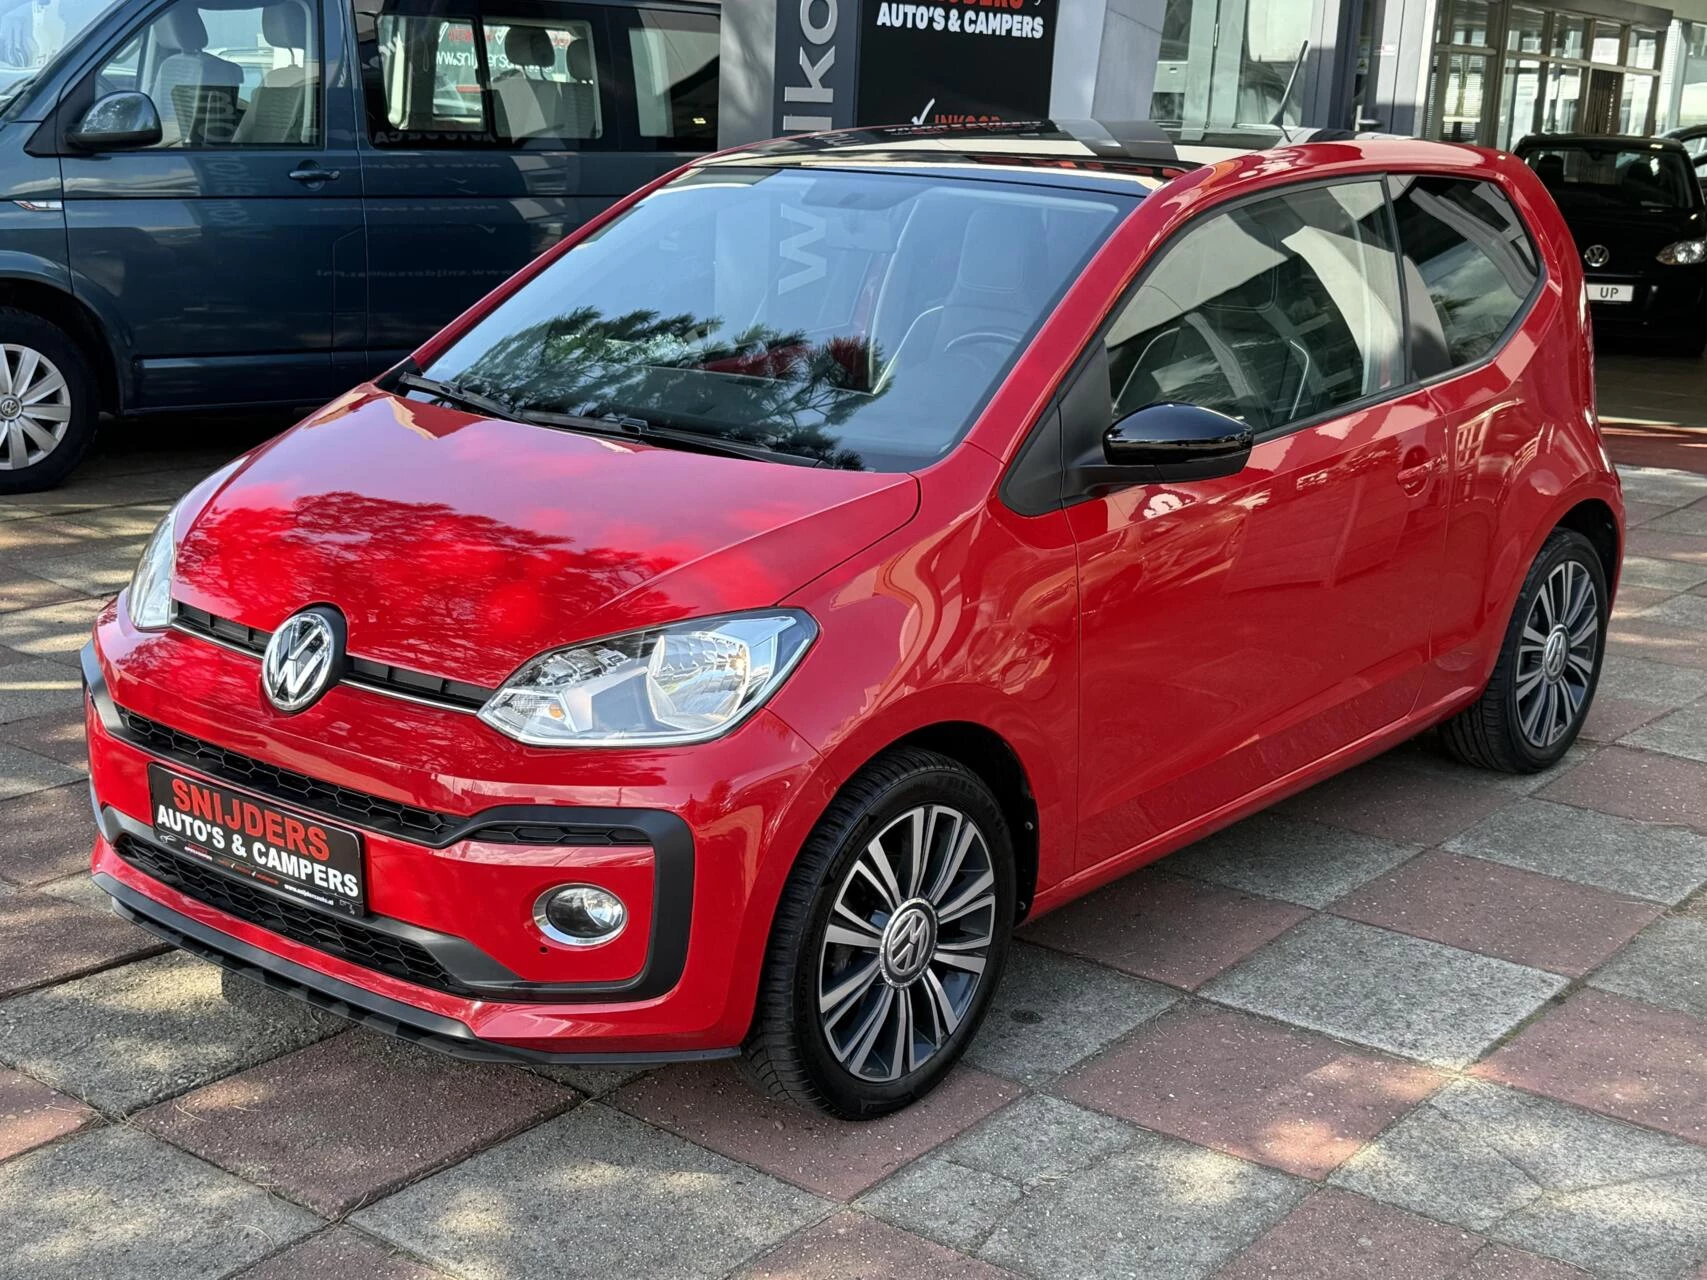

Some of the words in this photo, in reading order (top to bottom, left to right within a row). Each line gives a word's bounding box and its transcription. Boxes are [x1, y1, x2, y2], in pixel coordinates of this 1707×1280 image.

[877, 2, 945, 31] AUTO'S
[948, 9, 962, 33] &
[964, 10, 1044, 39] CAMPERS
[1600, 287, 1619, 299] UP
[171, 777, 331, 861] SNIJDERS
[157, 804, 225, 850] AUTO'S
[231, 834, 248, 858] &
[252, 841, 359, 898] CAMPERS
